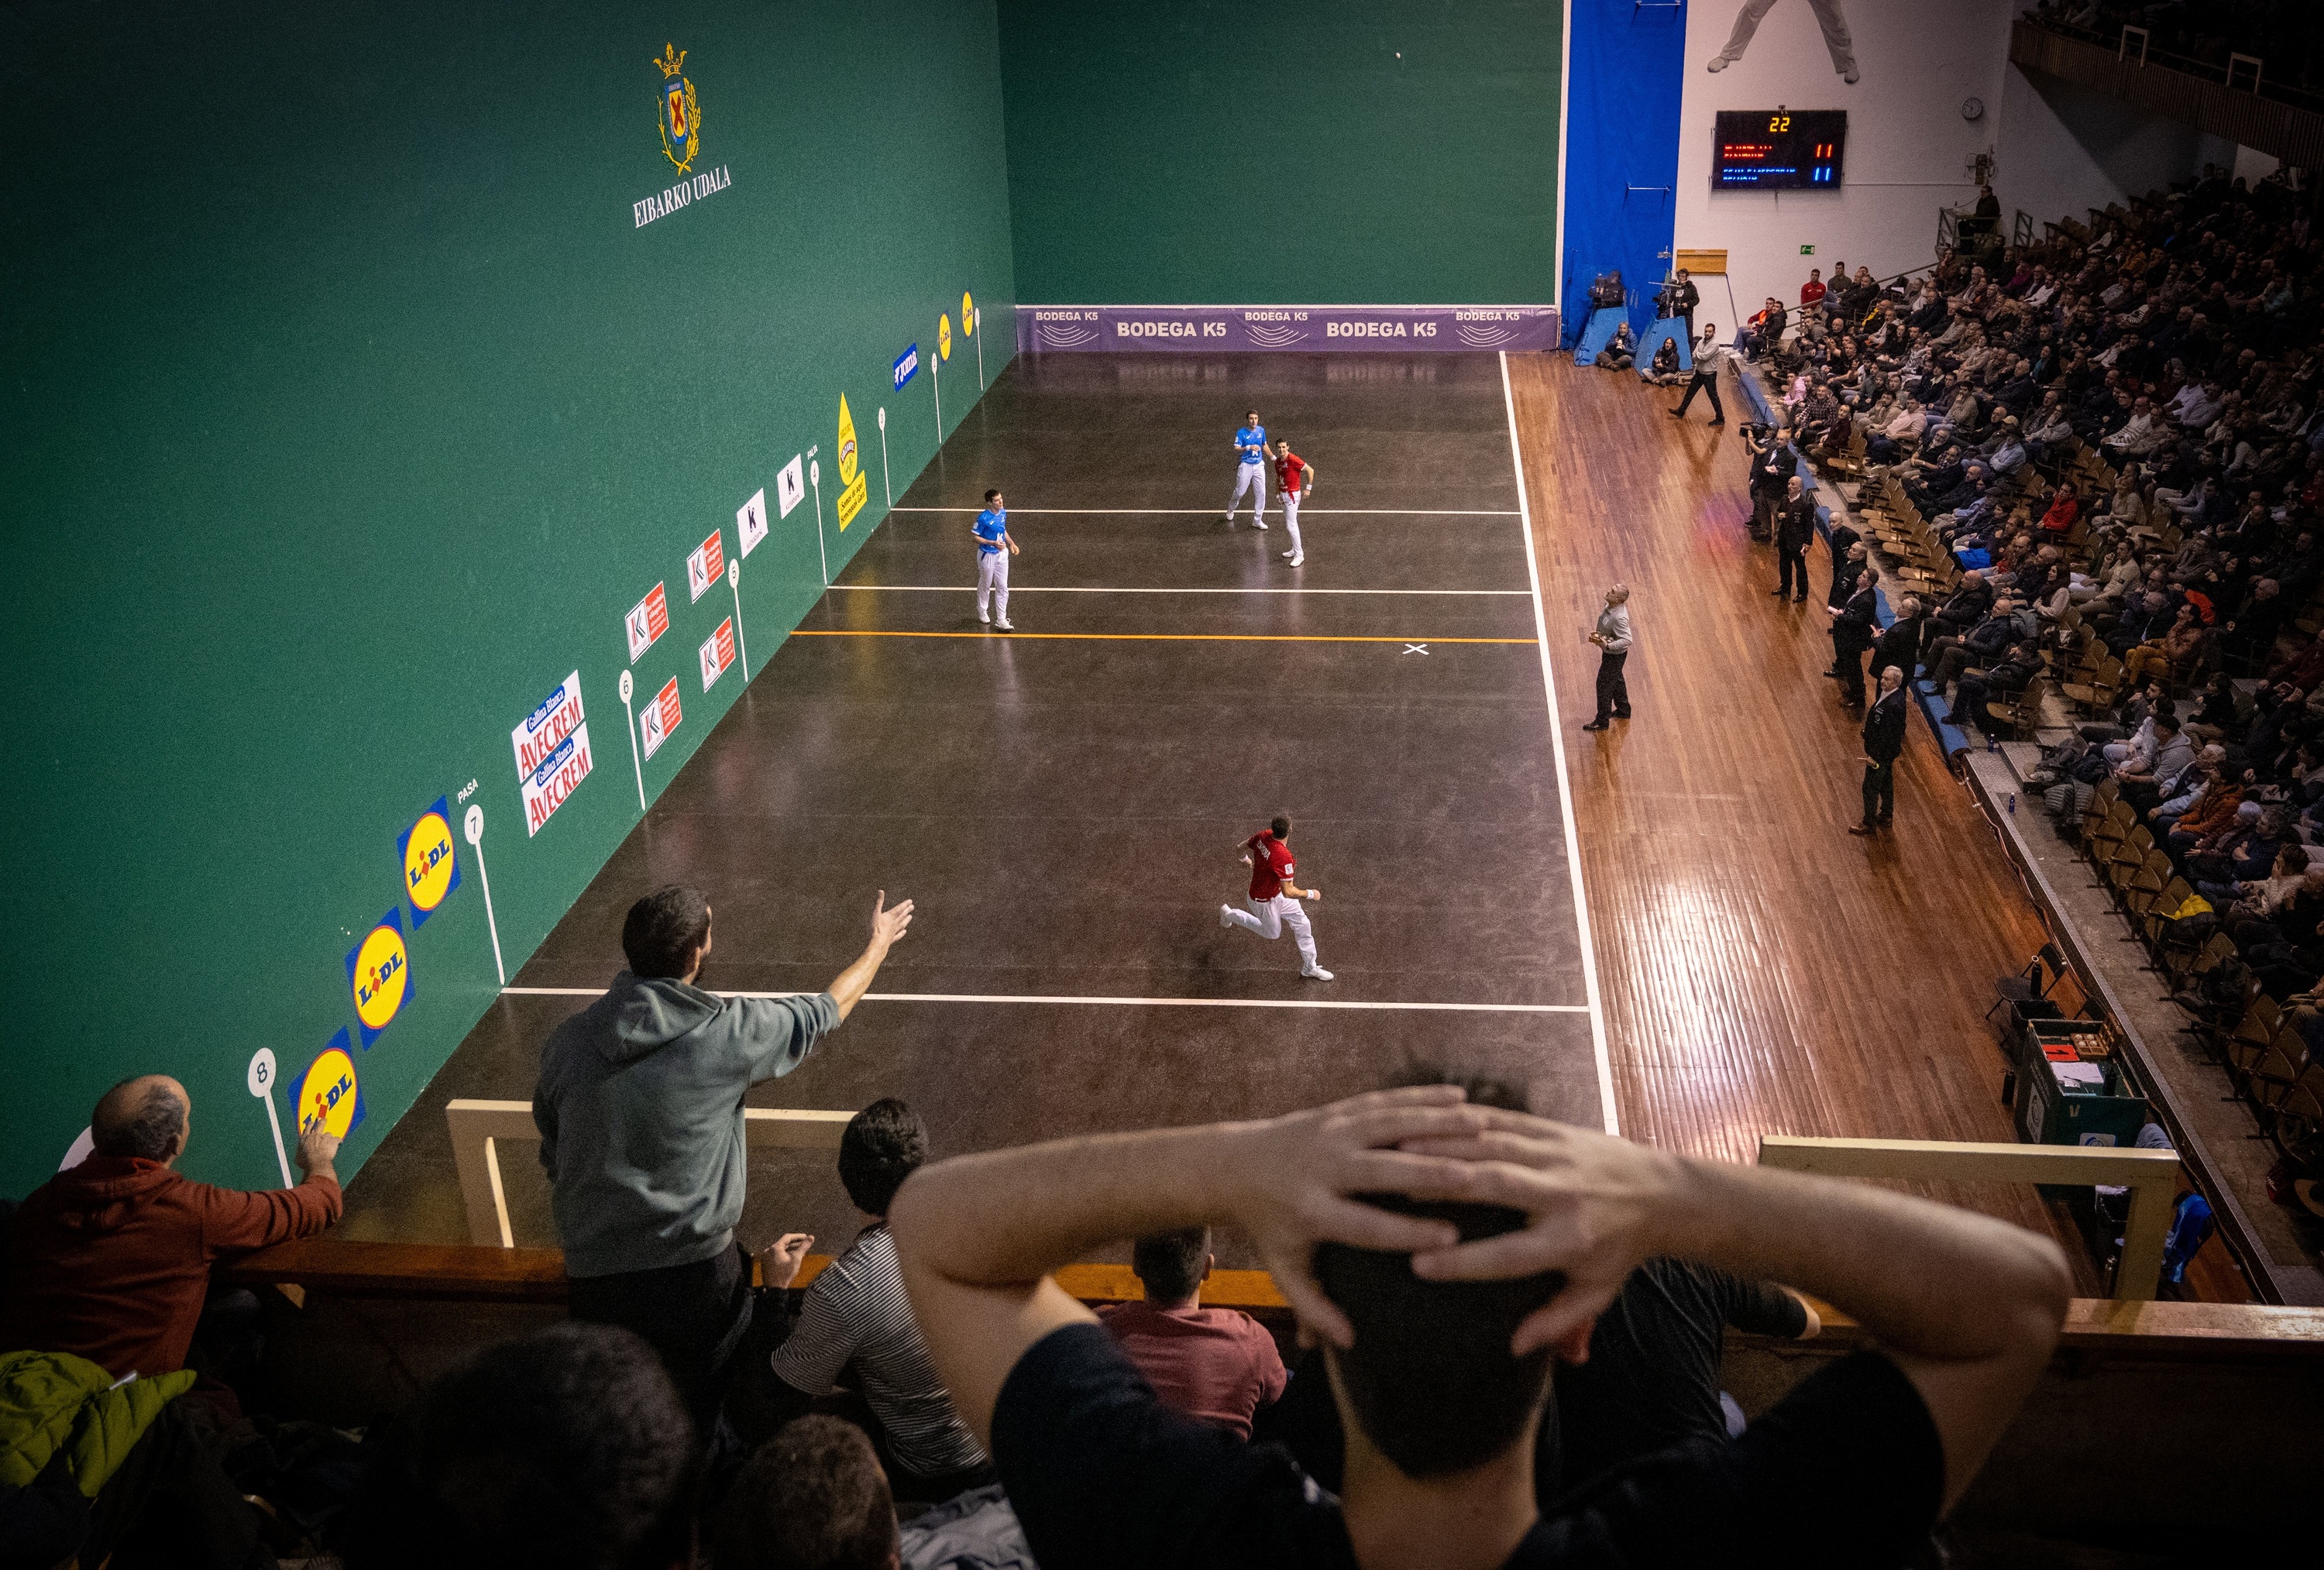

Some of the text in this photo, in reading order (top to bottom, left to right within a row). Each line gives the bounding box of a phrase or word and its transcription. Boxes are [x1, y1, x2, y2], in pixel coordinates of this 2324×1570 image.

[1769, 117, 1790, 132] 22
[1816, 144, 1833, 158] 11
[1813, 167, 1831, 181] 11
[633, 164, 732, 228] EIBARKO UDALA
[1036, 311, 1098, 321] BODEGA K5
[1245, 311, 1308, 321] BODEGA K5
[1456, 311, 1521, 321] BODEGA K5
[1117, 322, 1227, 337] BODEGA K5
[1326, 322, 1438, 337] BODEGA K5
[731, 565, 737, 579] 5
[624, 680, 629, 696] 6
[528, 689, 565, 730] Gallina Blanca
[520, 695, 583, 780] AVECREM
[538, 741, 573, 784] Gallina Blanca
[458, 778, 479, 805] PASA
[530, 746, 590, 834] AVECREM
[470, 816, 477, 834] 7
[256, 1062, 268, 1084] 8
